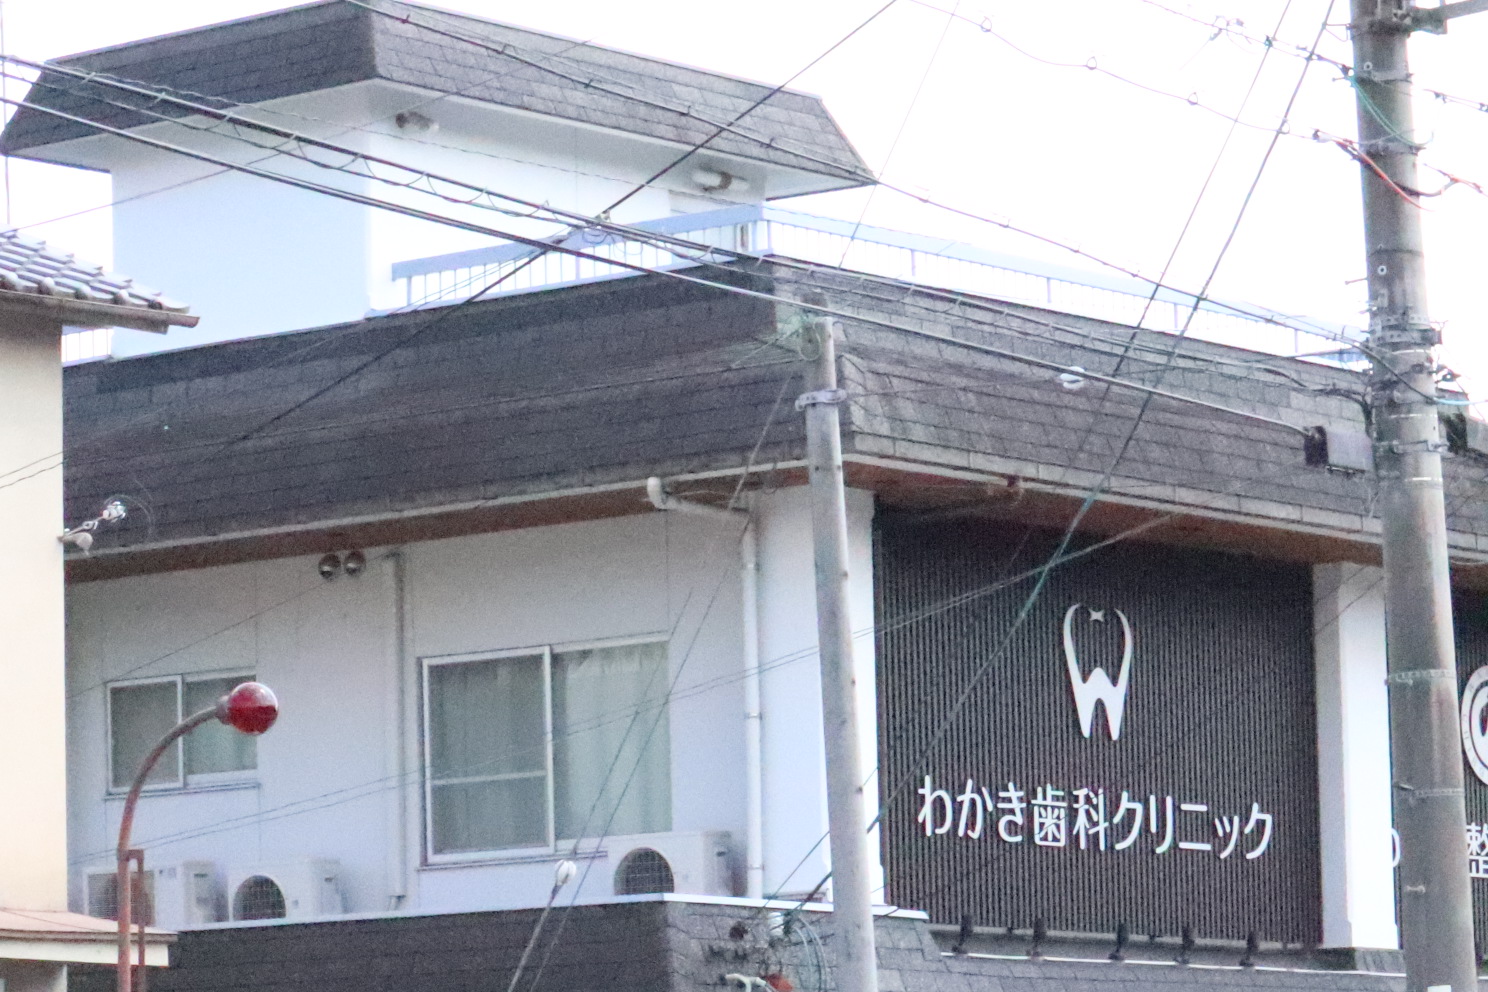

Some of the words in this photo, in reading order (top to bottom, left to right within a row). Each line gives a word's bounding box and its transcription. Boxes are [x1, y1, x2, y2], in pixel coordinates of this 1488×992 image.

[917, 774, 1275, 861] わかき歯科クリニック
